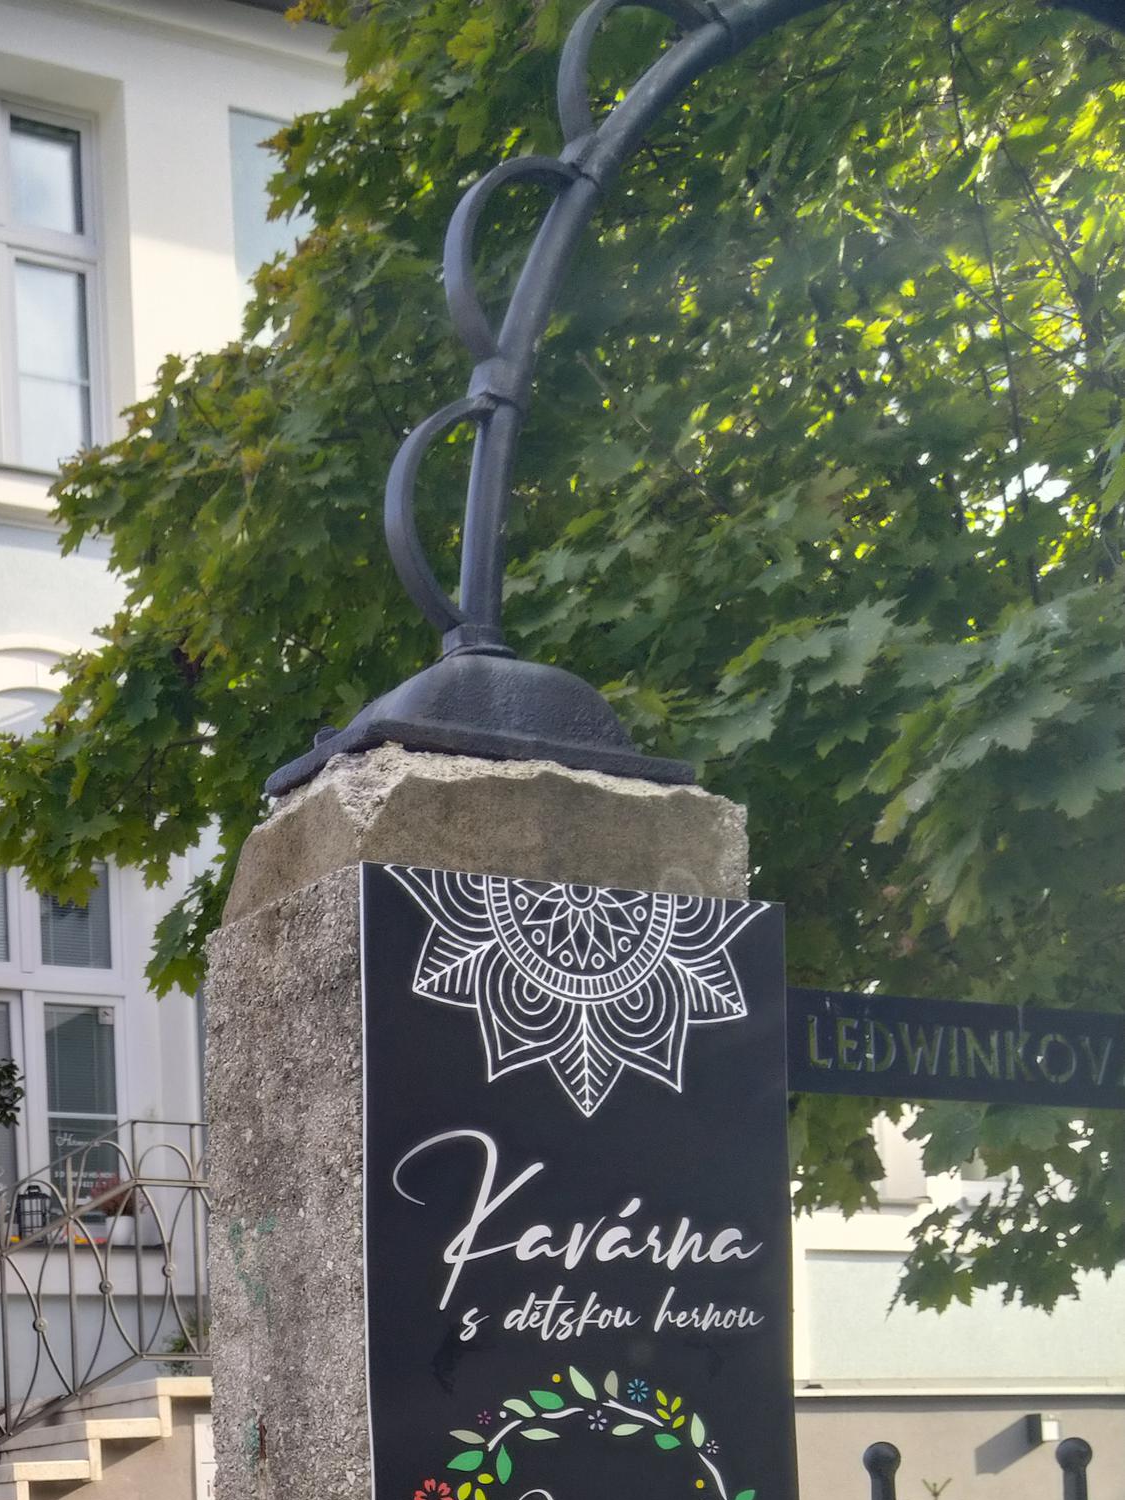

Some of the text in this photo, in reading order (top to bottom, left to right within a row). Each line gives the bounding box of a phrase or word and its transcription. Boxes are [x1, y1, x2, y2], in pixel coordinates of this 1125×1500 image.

[806, 1014, 1125, 1086] LEDWINKOV
[392, 1129, 763, 1310] Kavárna
[459, 1285, 765, 1341] s dětskou hernou
